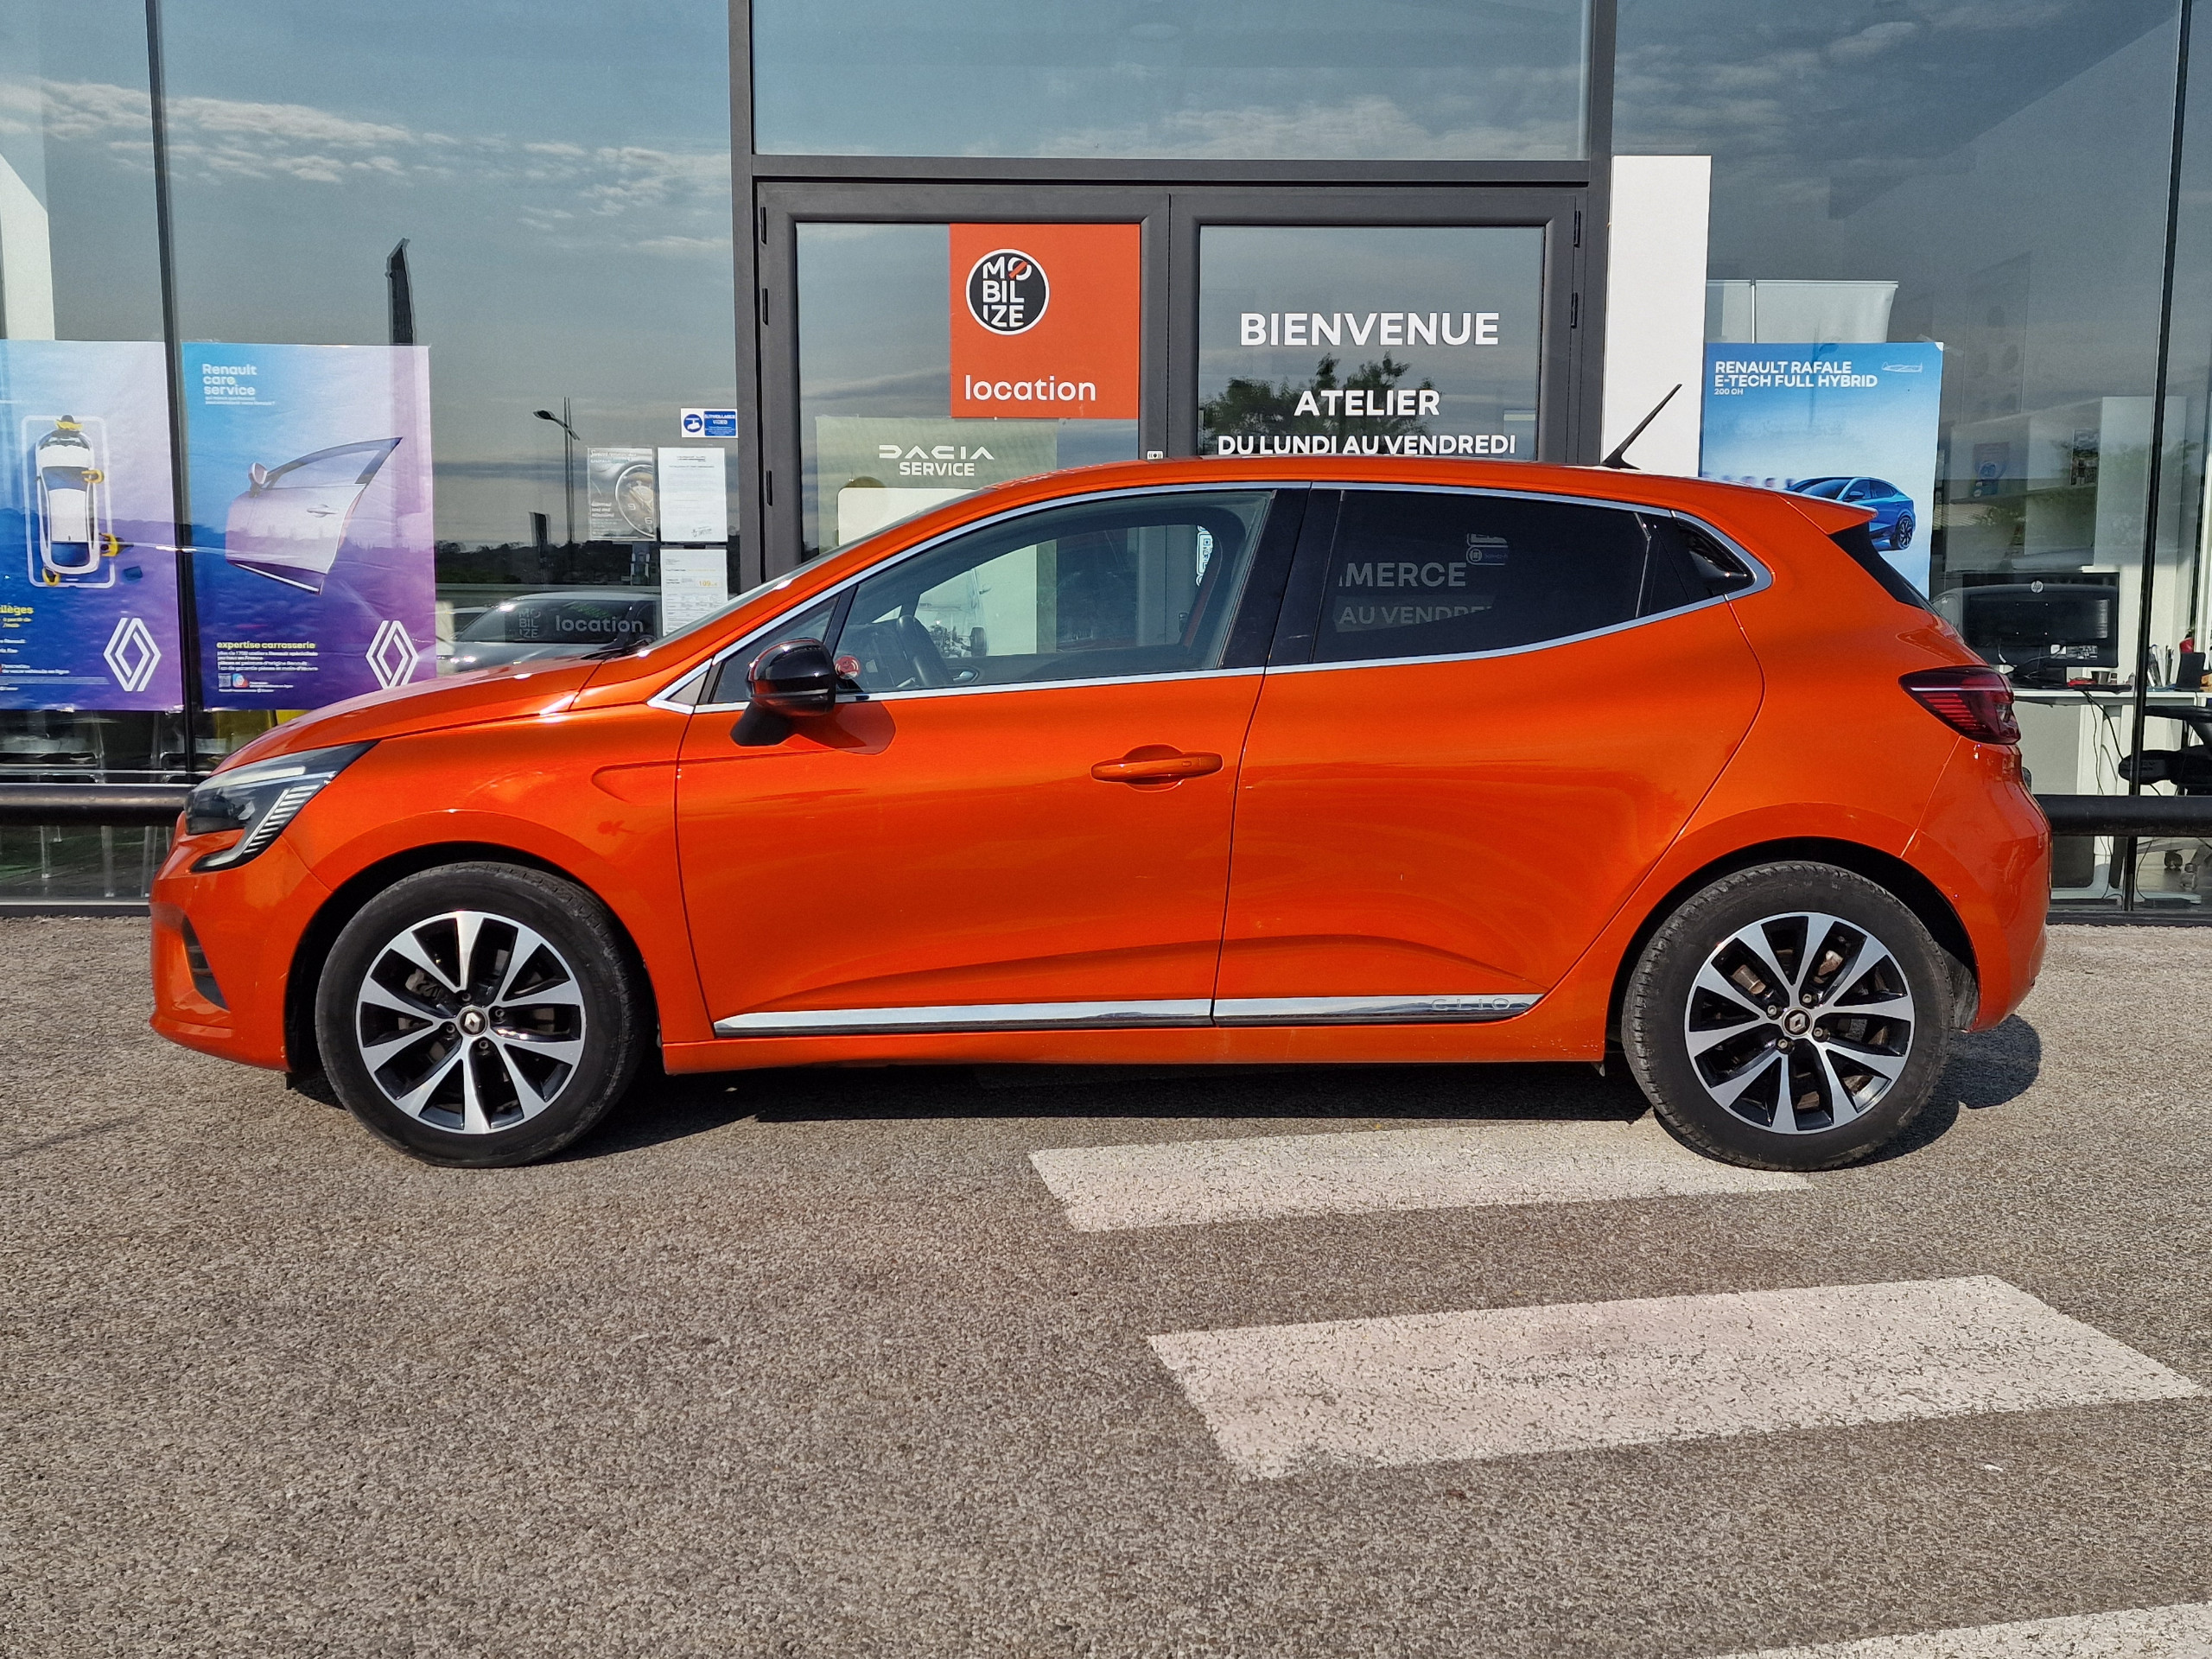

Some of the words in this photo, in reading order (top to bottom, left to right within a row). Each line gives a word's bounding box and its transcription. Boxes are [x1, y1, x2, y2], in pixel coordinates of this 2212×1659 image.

[1240, 312, 1500, 346] BIENVENUE
[202, 363, 257, 375] Renault
[1715, 361, 1789, 374] RENAULT
[1790, 361, 1853, 374] RAFALE
[203, 376, 236, 385] care
[964, 374, 1096, 402] location
[1714, 374, 1771, 387] E-TECH
[1775, 375, 1815, 388] FULL
[1818, 375, 1878, 388] HYBRID
[204, 385, 256, 396] service
[1294, 390, 1440, 416] ATELIER
[879, 444, 995, 461] DACIA
[1217, 435, 1254, 455] DU
[1260, 435, 1337, 455] LUNDI
[1342, 435, 1379, 455] AU
[1384, 435, 1516, 454] VENDREDI
[899, 462, 975, 477] SERVICE
[1339, 563, 1467, 588] MERCE
[556, 614, 644, 633] location
[1339, 606, 1376, 625] AU
[217, 640, 260, 650] expertise
[1432, 997, 1510, 1011] CLIO
